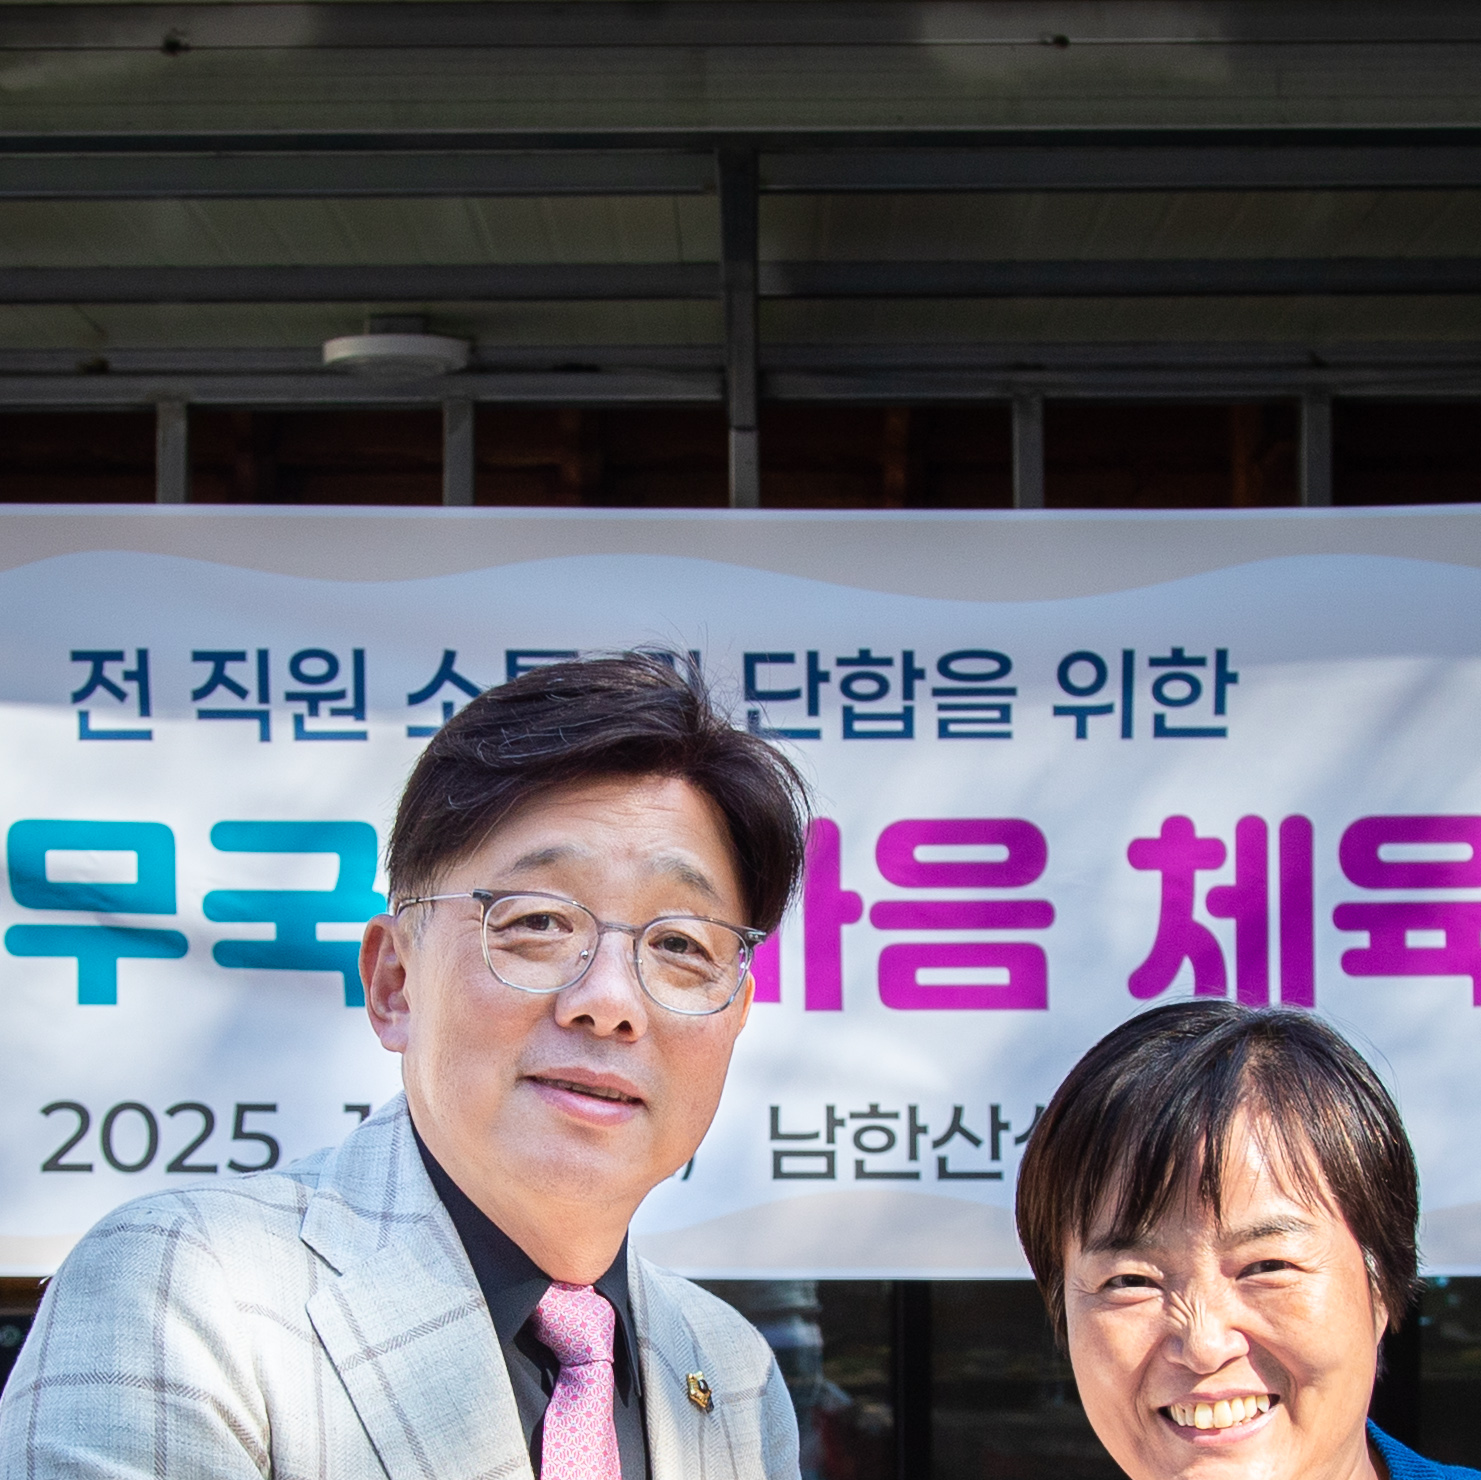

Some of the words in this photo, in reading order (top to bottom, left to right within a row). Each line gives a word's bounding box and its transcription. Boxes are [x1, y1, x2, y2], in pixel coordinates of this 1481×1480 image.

[70, 647, 154, 741] 전
[190, 647, 369, 742] 직원
[743, 648, 1017, 740] 단합을
[1053, 647, 1239, 740] 위한
[39, 1100, 281, 1174] 2025
[769, 1103, 1047, 1180] 남한산
